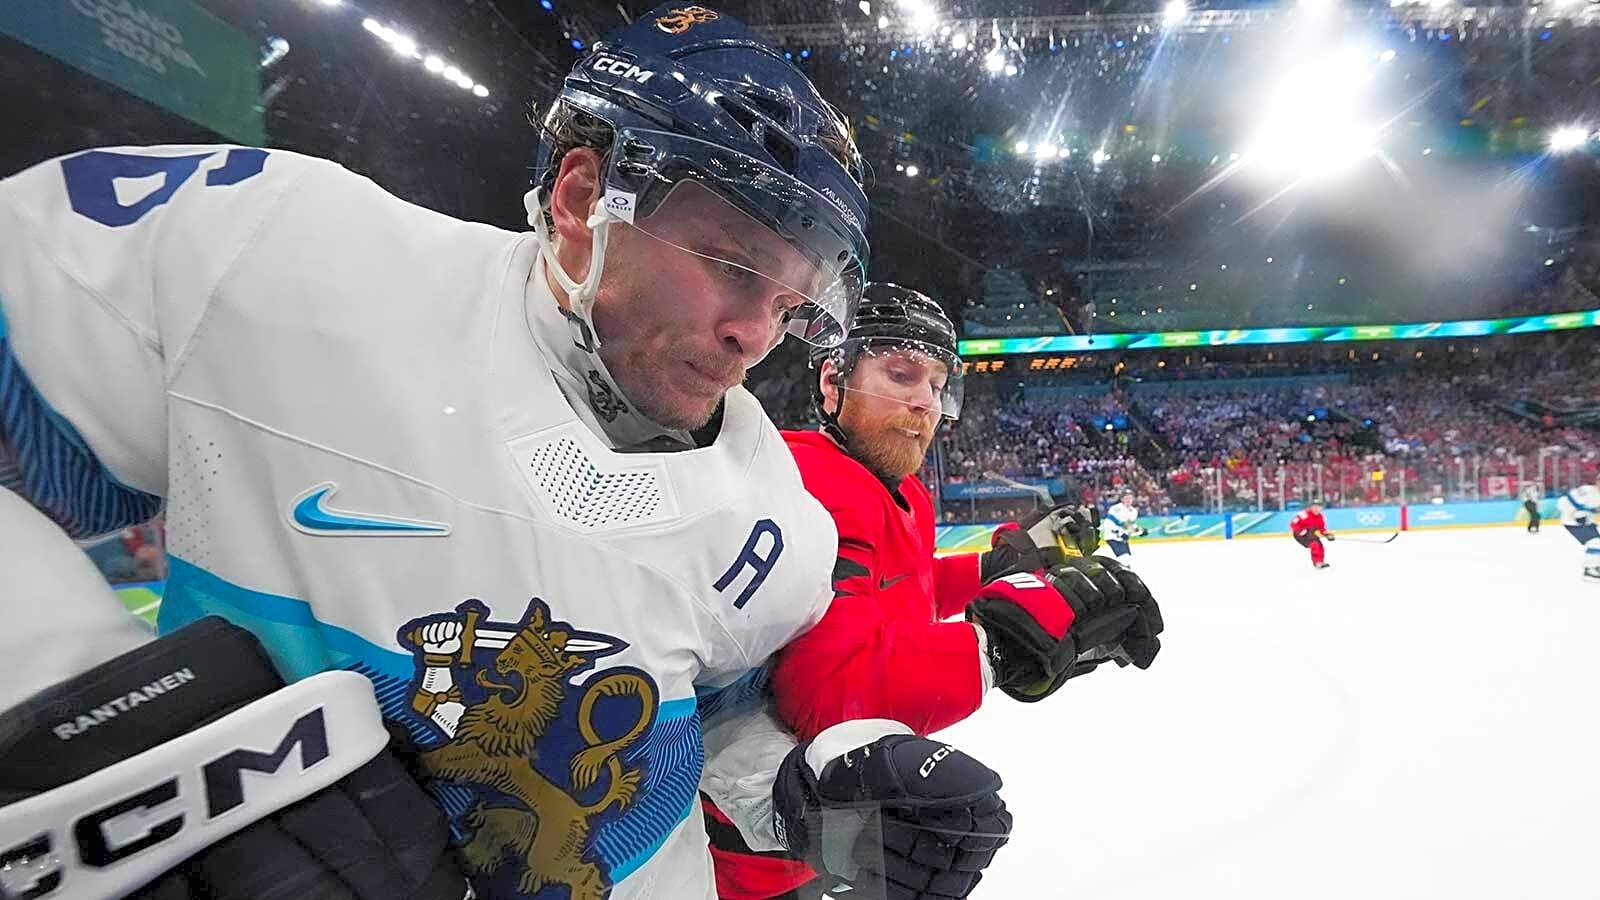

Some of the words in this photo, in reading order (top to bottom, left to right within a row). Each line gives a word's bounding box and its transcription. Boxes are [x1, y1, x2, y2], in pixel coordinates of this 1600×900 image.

[593, 57, 654, 83] CCM
[821, 187, 847, 212] MILANO
[960, 487, 994, 495] MILANO
[712, 518, 785, 610] A
[53, 667, 198, 741] RANTANEN
